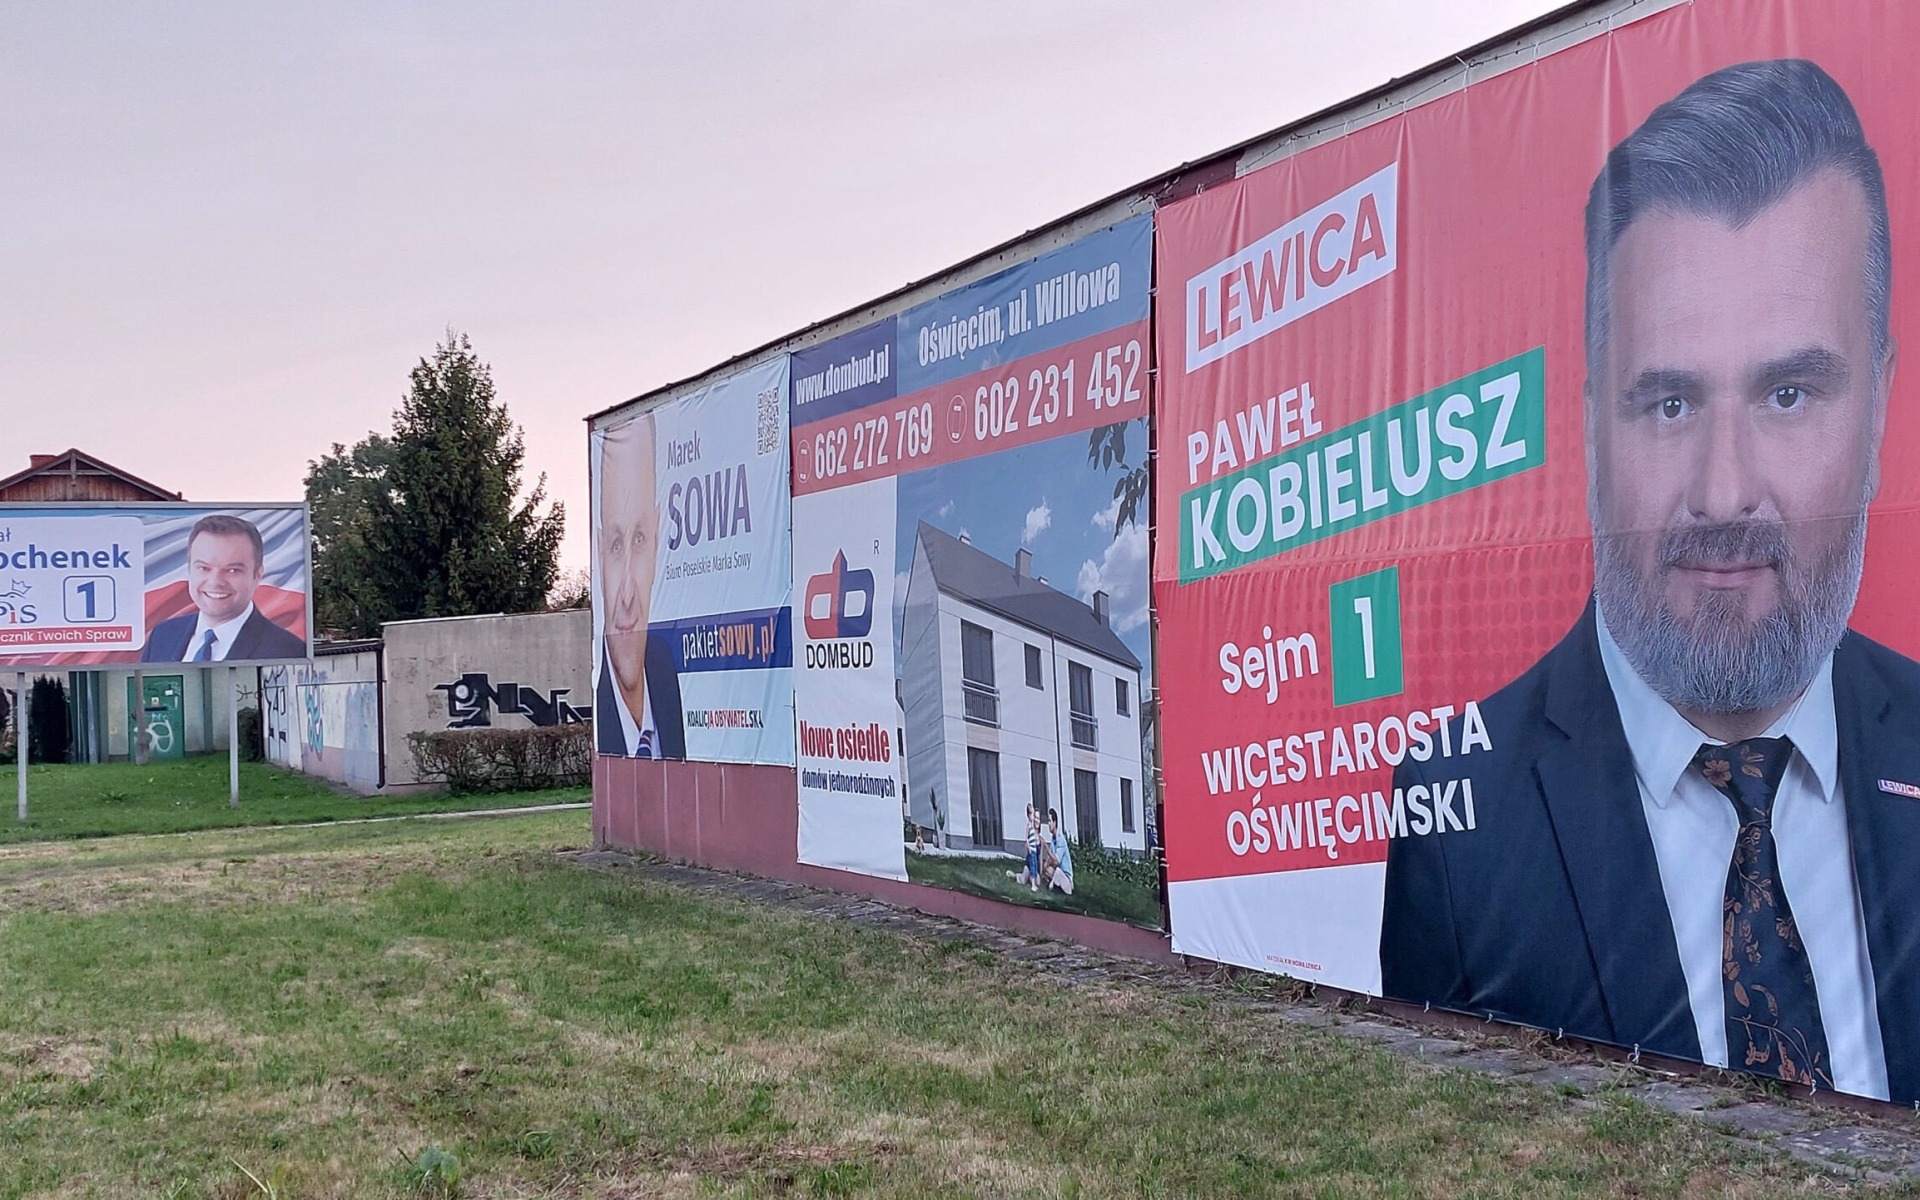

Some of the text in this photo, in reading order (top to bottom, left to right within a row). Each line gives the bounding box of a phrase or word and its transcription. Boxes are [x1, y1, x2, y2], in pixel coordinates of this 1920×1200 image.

[1198, 192, 1387, 353] LEWICA
[918, 262, 1120, 367] Oświęcim, ul. Willowa
[795, 344, 890, 406] www.dombud.pl
[974, 339, 1142, 441] 602 231 452
[667, 430, 701, 470] Marek
[814, 402, 933, 480] 662 272 769
[1187, 381, 1323, 485] PAWEŁ
[1190, 371, 1527, 569] KOBIELUSZ
[668, 463, 752, 551] SOWA
[76, 580, 97, 619] 1
[683, 556, 711, 578] Poselskie
[712, 552, 732, 572] Marka
[733, 551, 752, 571] Sowy
[37, 630, 82, 643] Twoich
[86, 629, 128, 643] Spraw
[682, 616, 775, 667] pakietsowy.pl
[806, 641, 874, 669] DOMBUD
[1219, 596, 1376, 704] Sejm 1
[687, 709, 714, 729] KOALICJA
[800, 720, 890, 763] Nowe osiedle
[1200, 700, 1493, 796] WICESTAROSTA
[802, 767, 895, 799] domów jednorodzinnych
[1225, 778, 1478, 859] OŚWIĘCIMSKI
